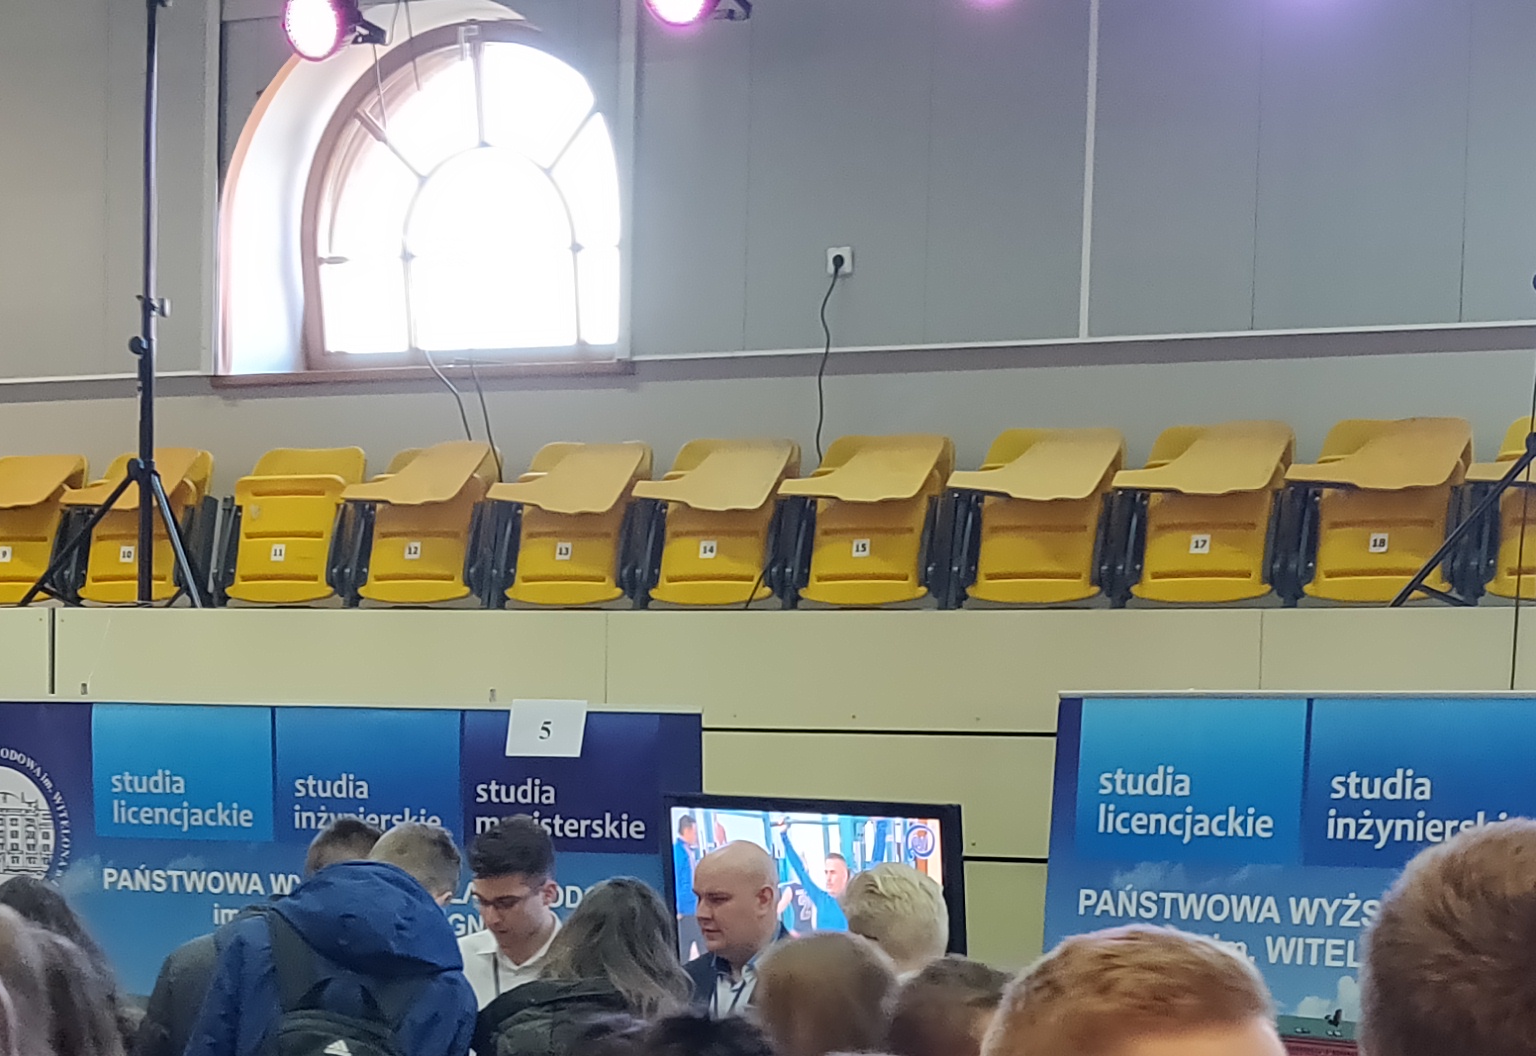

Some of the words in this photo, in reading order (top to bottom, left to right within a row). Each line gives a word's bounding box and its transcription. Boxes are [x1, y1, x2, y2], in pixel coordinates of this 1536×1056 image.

[539, 720, 552, 740] 5
[111, 770, 185, 794] studia
[294, 773, 369, 799] studia
[475, 778, 556, 804] studia
[1098, 765, 1191, 796] studia
[1330, 768, 1432, 800] studia
[112, 800, 254, 831] licencjackie
[294, 804, 443, 831] inżierskie
[475, 811, 646, 839] misterskie
[1097, 804, 1274, 844] licencjackie
[102, 864, 265, 895] PAŃSTWOWA
[1077, 884, 1281, 924] PAŃSTWOWA
[1288, 892, 1381, 928] WYŻS
[1265, 935, 1362, 968] WITEL
